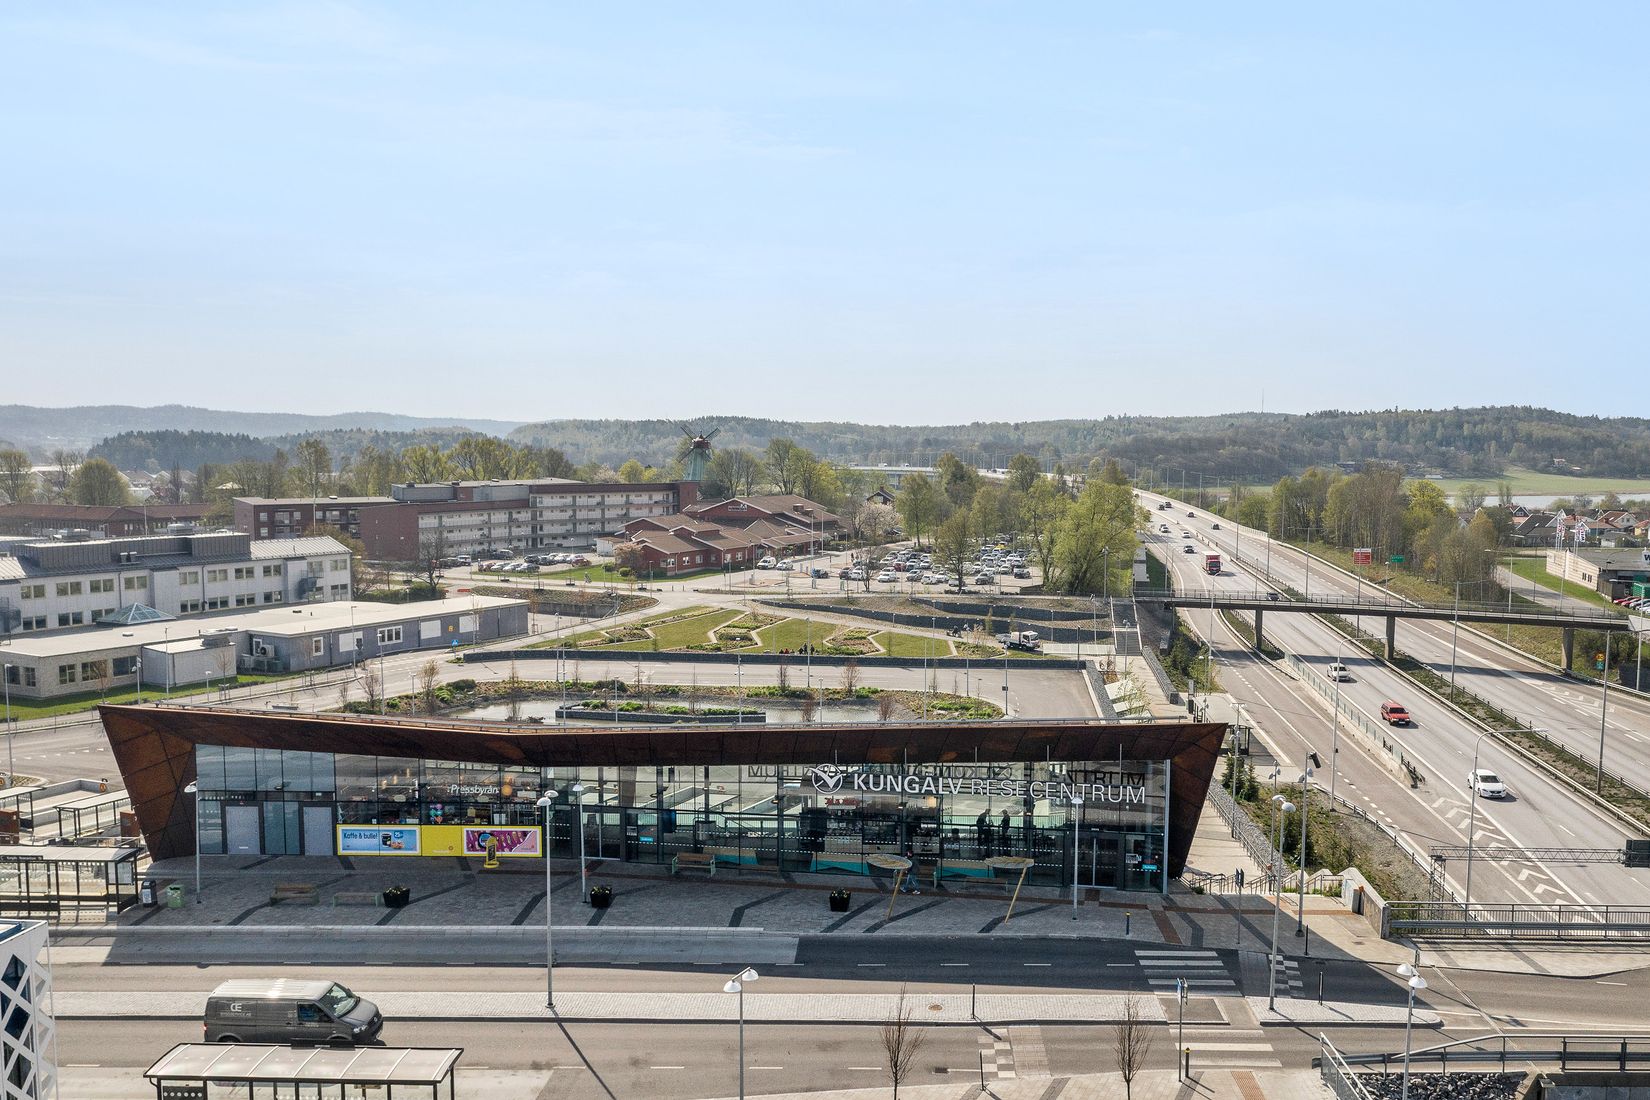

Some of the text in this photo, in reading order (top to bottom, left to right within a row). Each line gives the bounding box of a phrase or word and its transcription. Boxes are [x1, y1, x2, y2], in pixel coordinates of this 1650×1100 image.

[451, 784, 498, 796] Pressbyrån
[853, 772, 963, 795] KUNGÄLV
[971, 779, 1146, 804] RESECENTRUM
